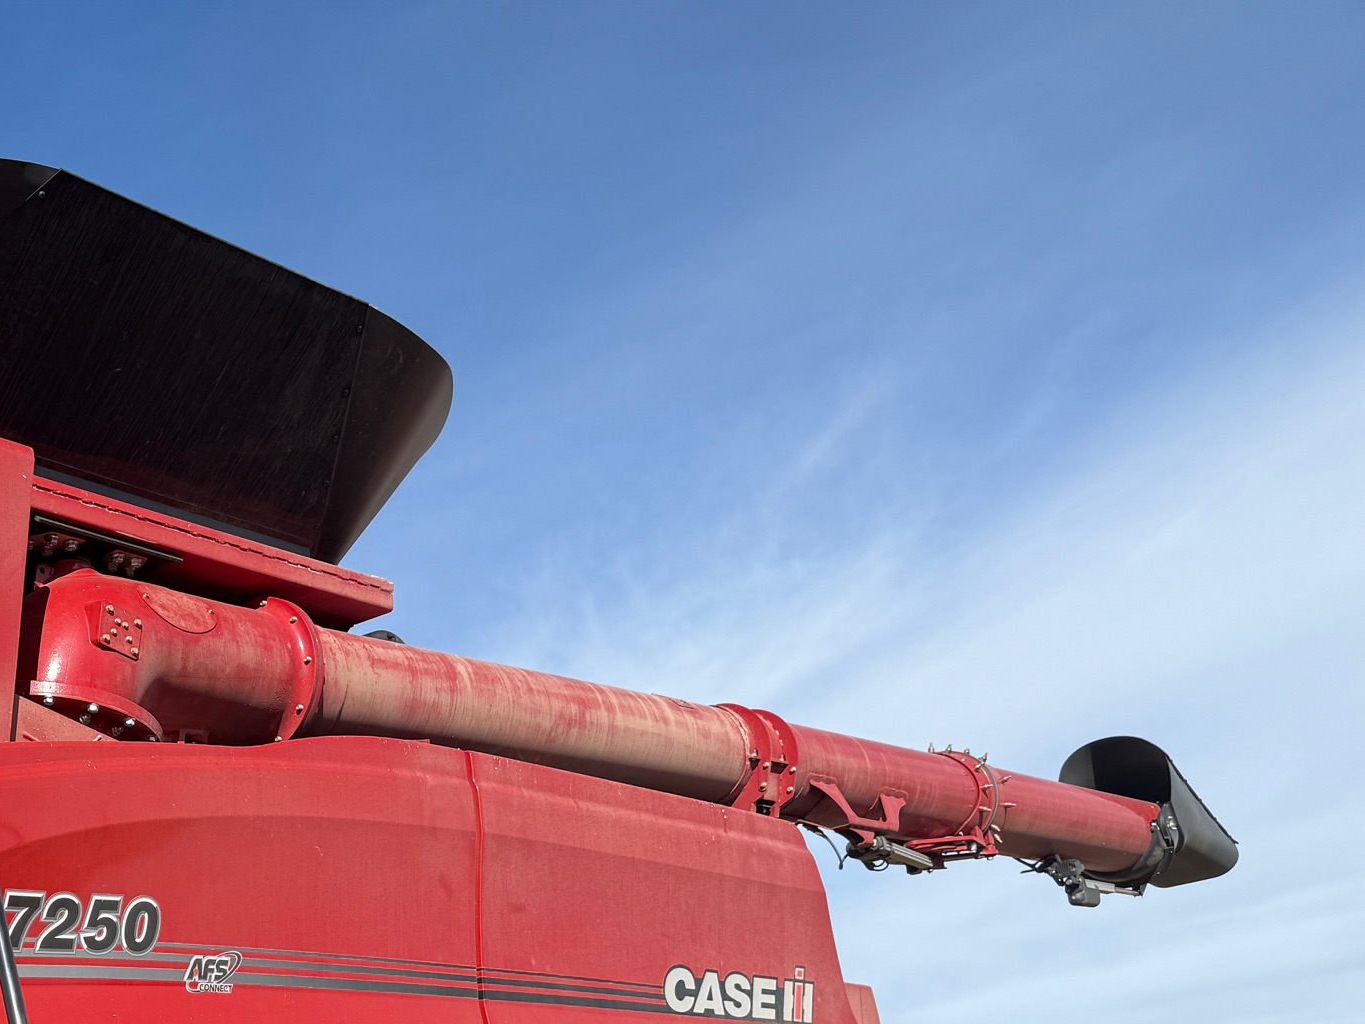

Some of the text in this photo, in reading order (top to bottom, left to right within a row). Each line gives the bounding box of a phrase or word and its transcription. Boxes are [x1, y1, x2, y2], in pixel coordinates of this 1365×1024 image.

[3, 889, 162, 956] 7250
[185, 954, 232, 983] AFS
[198, 982, 234, 994] CONNECT
[664, 964, 778, 1020] CASE
